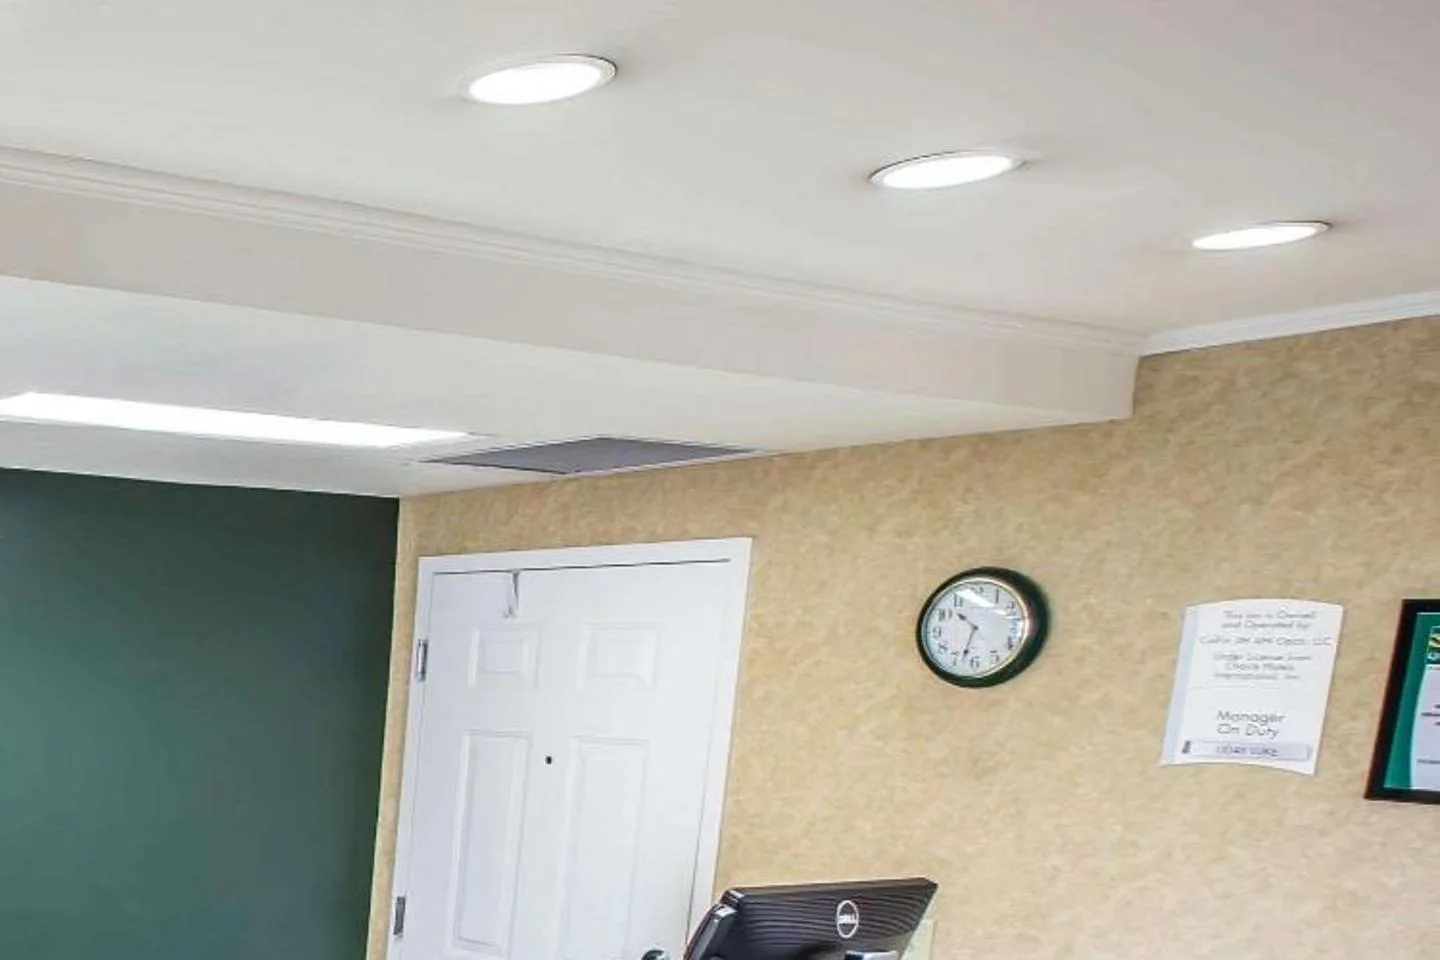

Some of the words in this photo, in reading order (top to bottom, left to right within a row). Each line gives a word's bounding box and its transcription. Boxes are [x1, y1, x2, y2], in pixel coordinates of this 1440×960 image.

[1216, 710, 1286, 727] Manager
[1216, 722, 1240, 735] On
[1245, 722, 1279, 741] Duty
